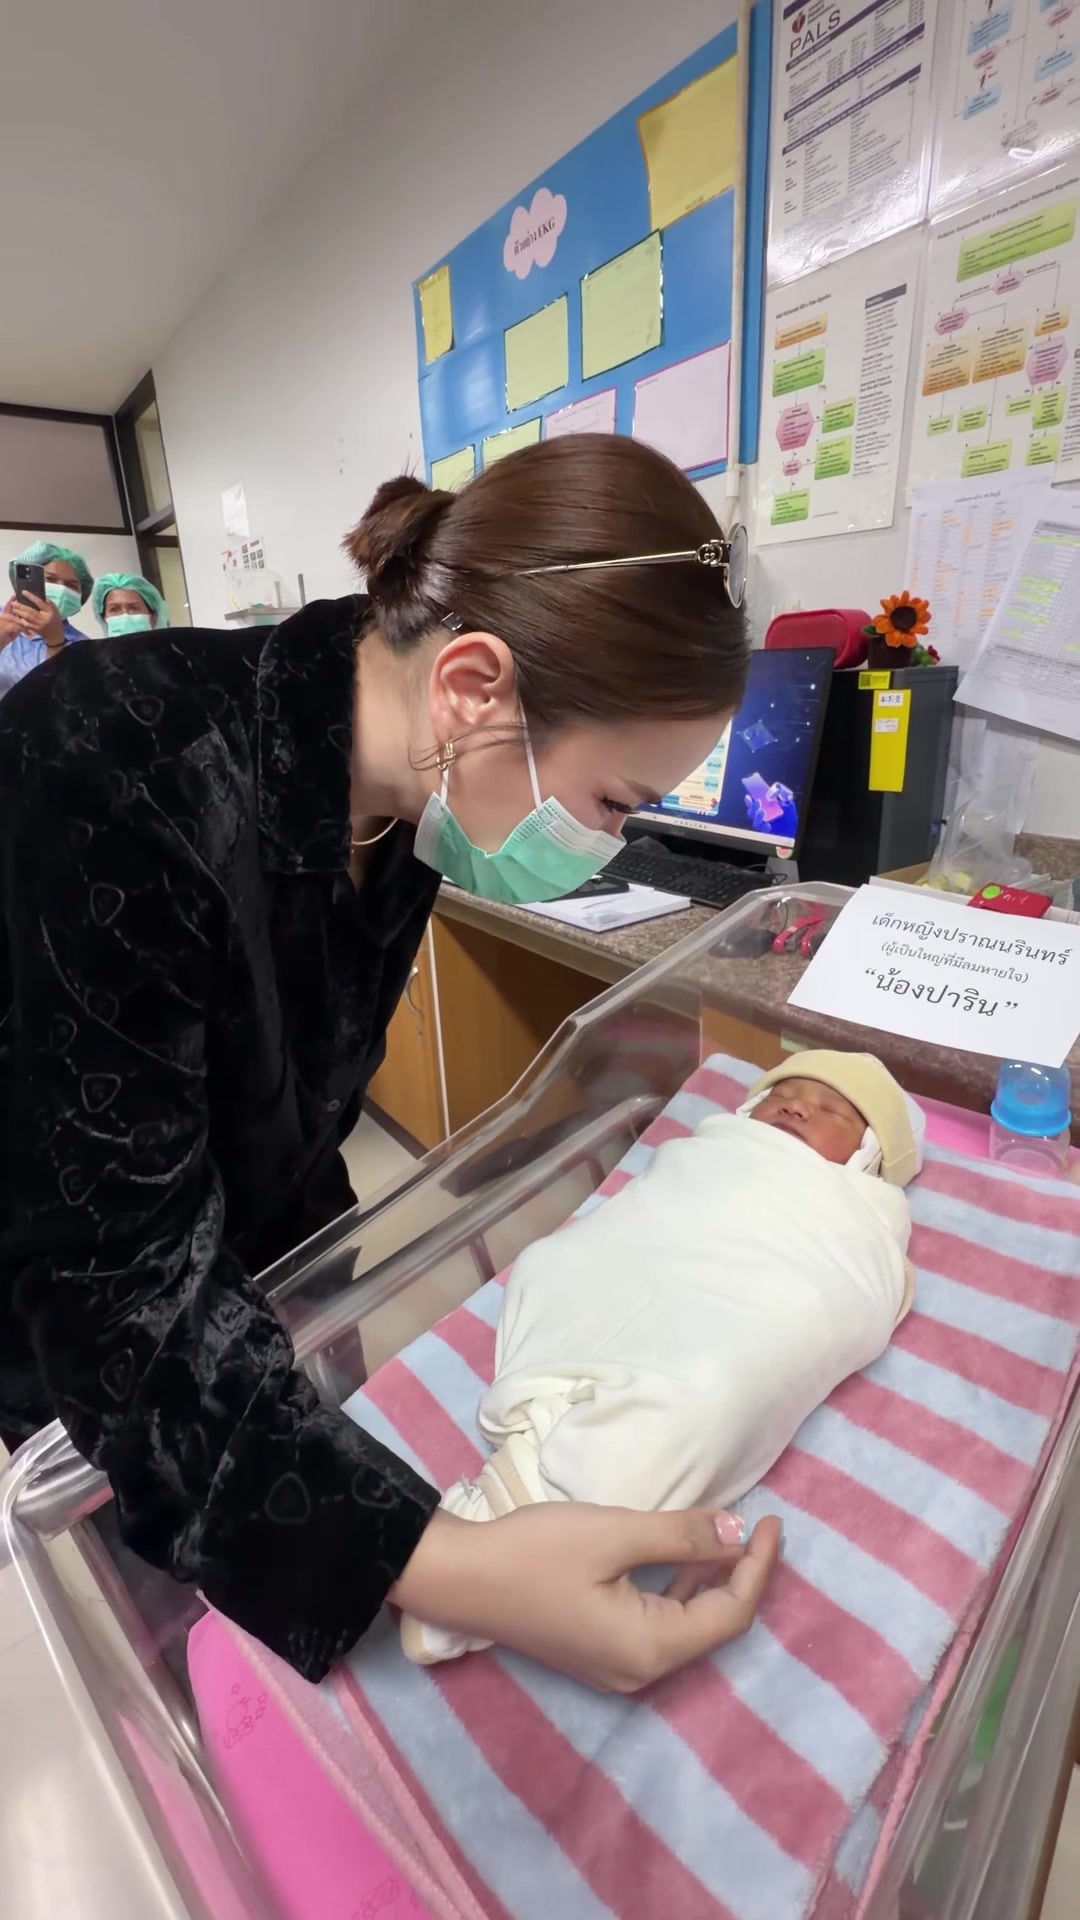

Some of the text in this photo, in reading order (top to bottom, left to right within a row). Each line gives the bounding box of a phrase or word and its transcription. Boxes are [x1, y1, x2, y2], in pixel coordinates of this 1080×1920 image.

[789, 9, 841, 57] PALS
[537, 216, 556, 238] EKG
[871, 912, 1073, 967] เด็กหญิงปราณนรินทร์
[880, 940, 1030, 984] (ผู้เป็นใหญ่ที่มีลมหายใจ)
